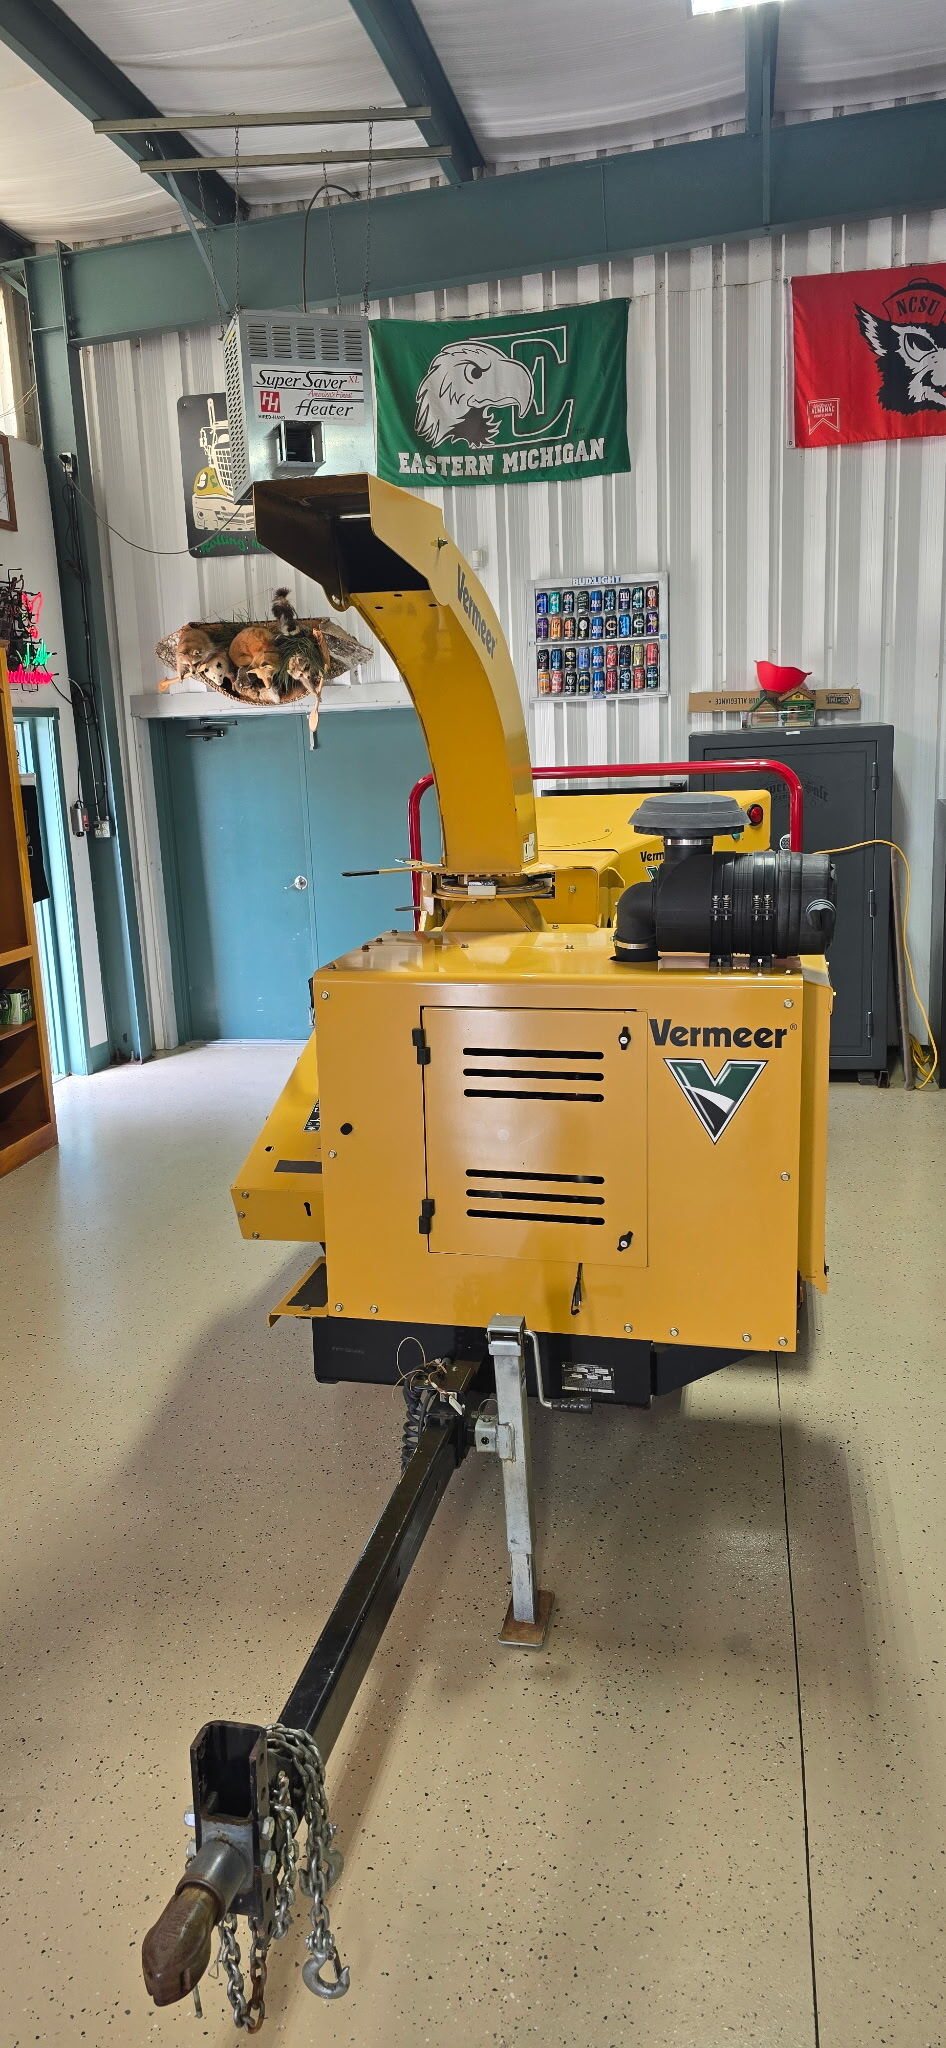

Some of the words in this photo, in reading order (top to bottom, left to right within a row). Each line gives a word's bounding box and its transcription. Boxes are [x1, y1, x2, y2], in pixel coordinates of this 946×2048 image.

[896, 296, 941, 316] NCSU
[256, 370, 301, 389] Super
[303, 371, 347, 389] Saver
[347, 376, 360, 384] XL
[295, 398, 353, 416] Heater
[398, 452, 494, 477] EASTERN
[502, 438, 605, 475] MICHIGAN
[572, 577, 592, 586] BUD
[592, 576, 621, 585] LIGHT
[457, 562, 496, 660] Vermeer
[640, 851, 664, 862] Verm
[649, 1018, 787, 1048] Vermeer
